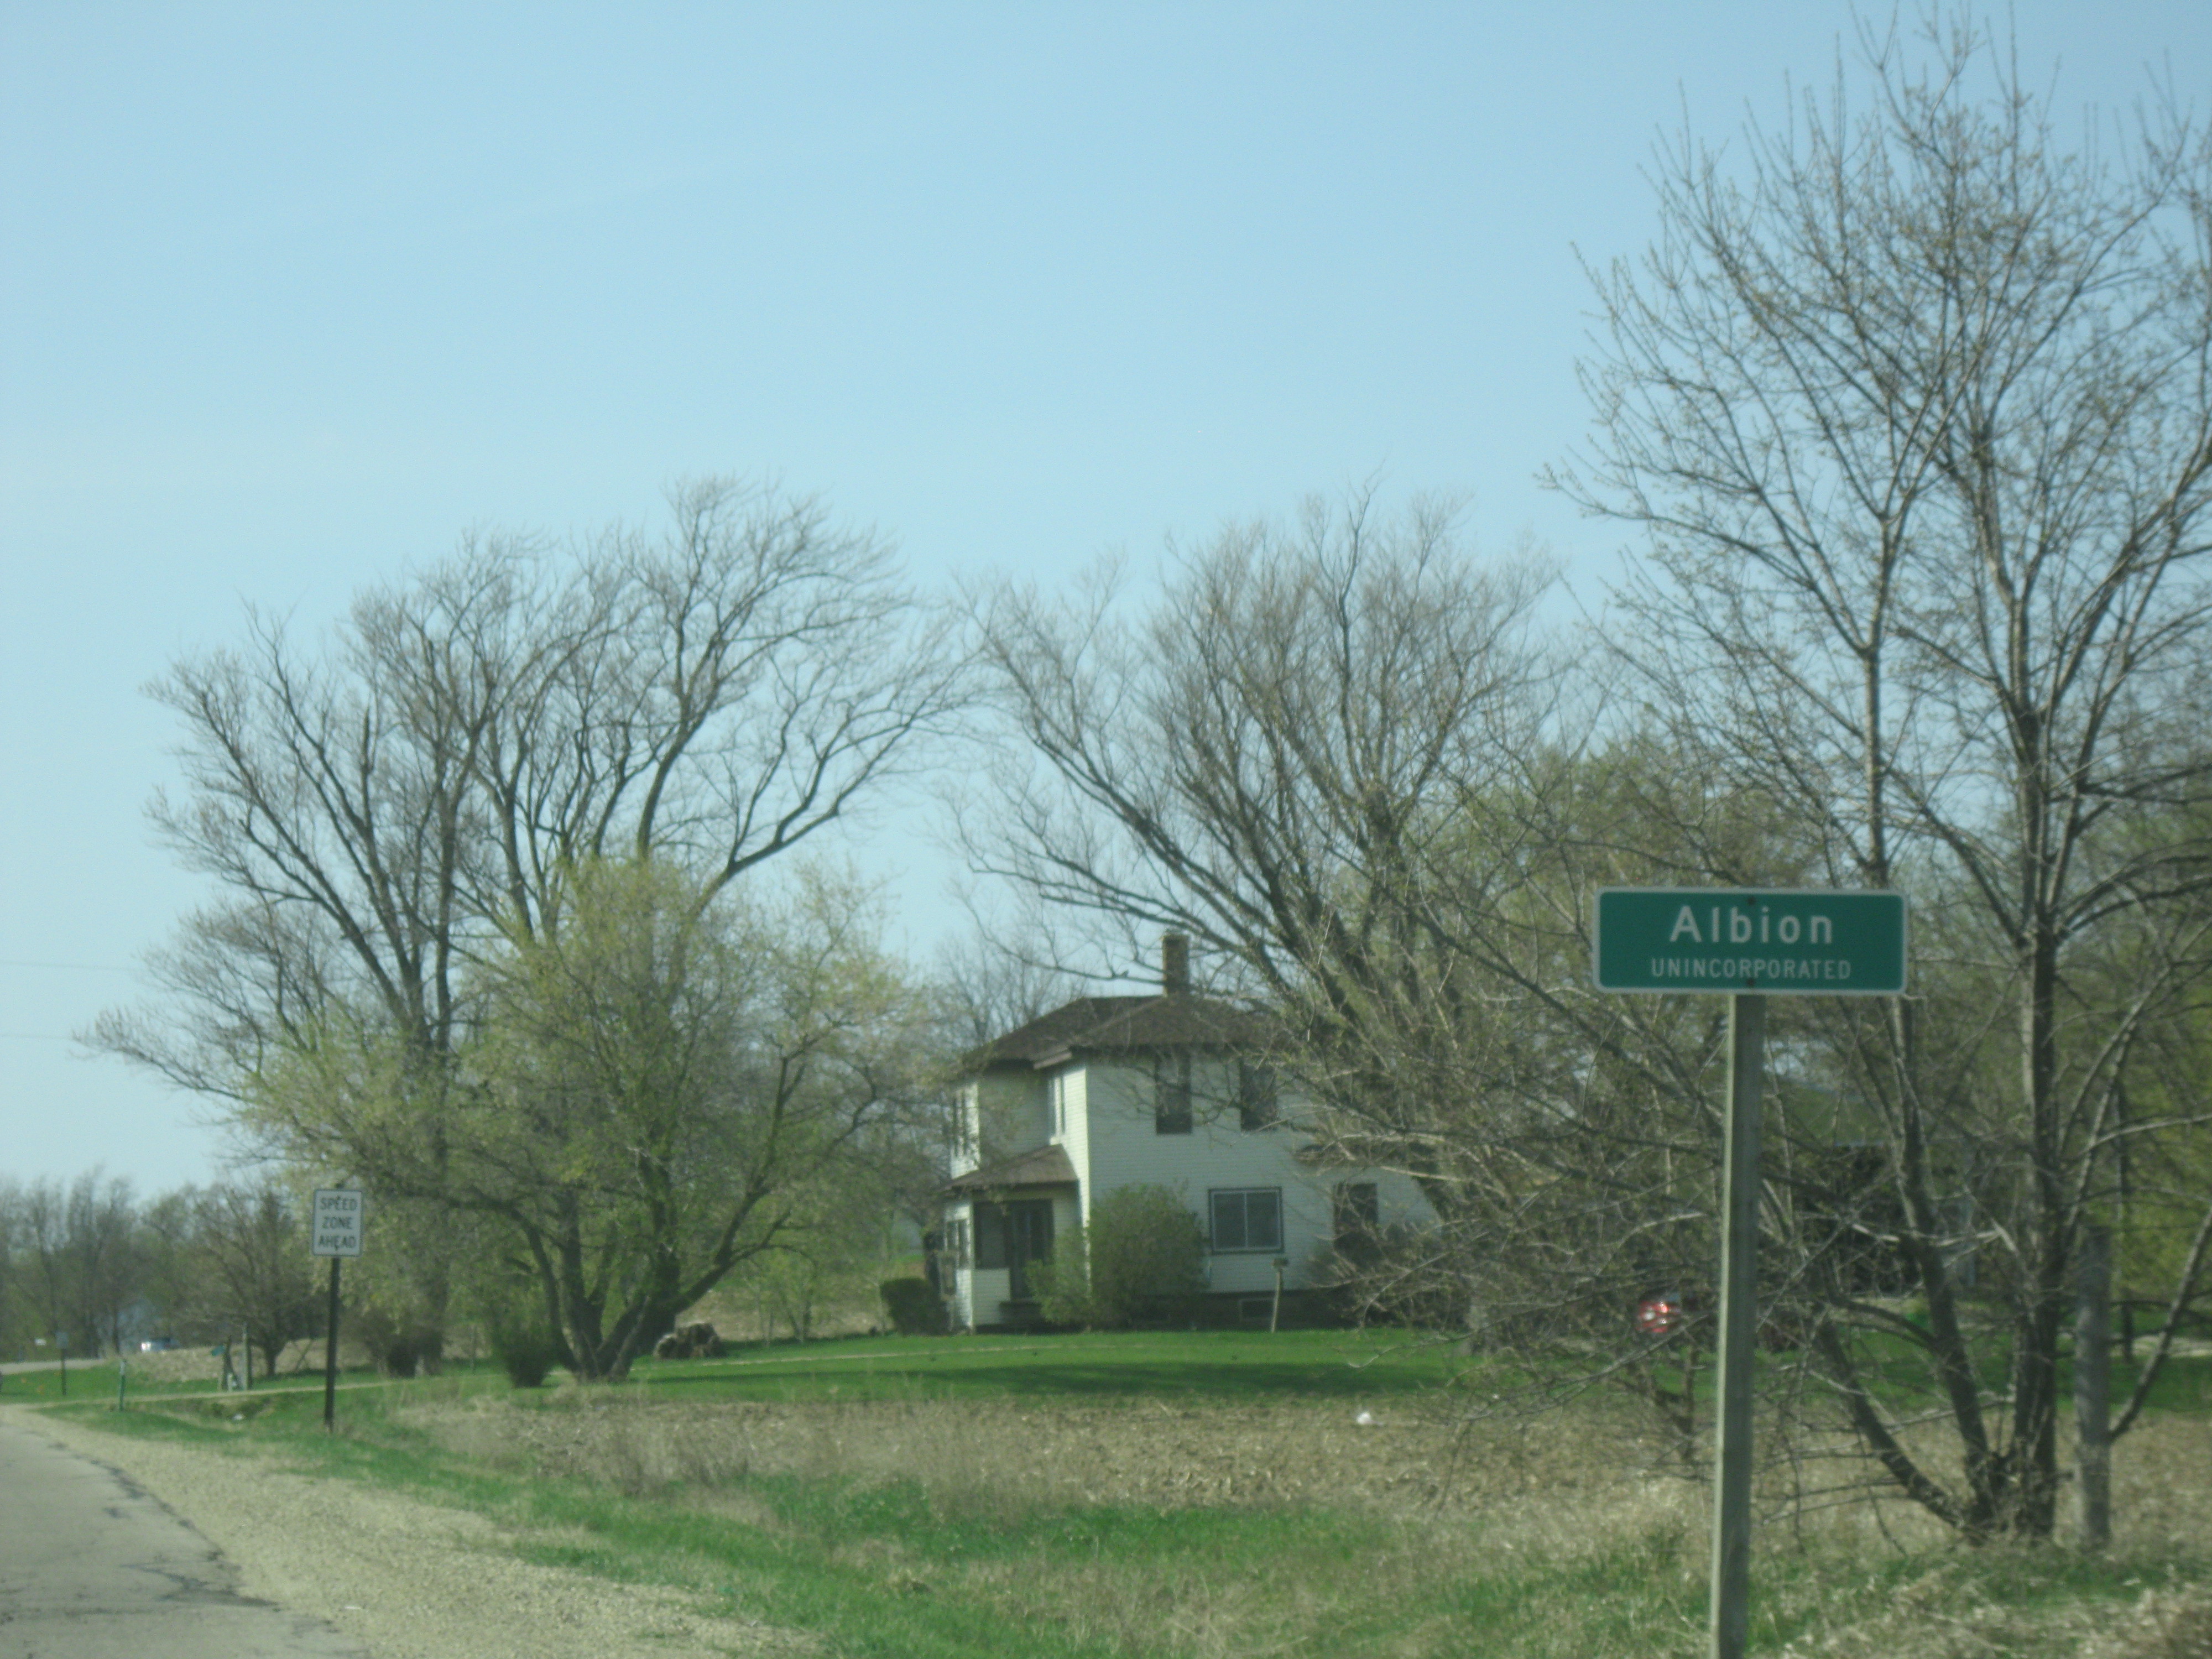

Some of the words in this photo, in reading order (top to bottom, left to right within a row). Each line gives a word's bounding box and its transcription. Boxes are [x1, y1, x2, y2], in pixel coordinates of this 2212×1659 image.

[1670, 905, 1833, 944] Albion
[1650, 957, 1851, 979] UNINCORPORATED
[320, 1197, 357, 1211] SPEED
[322, 1216, 352, 1229] ZONE
[319, 1235, 356, 1248] AHEAD
